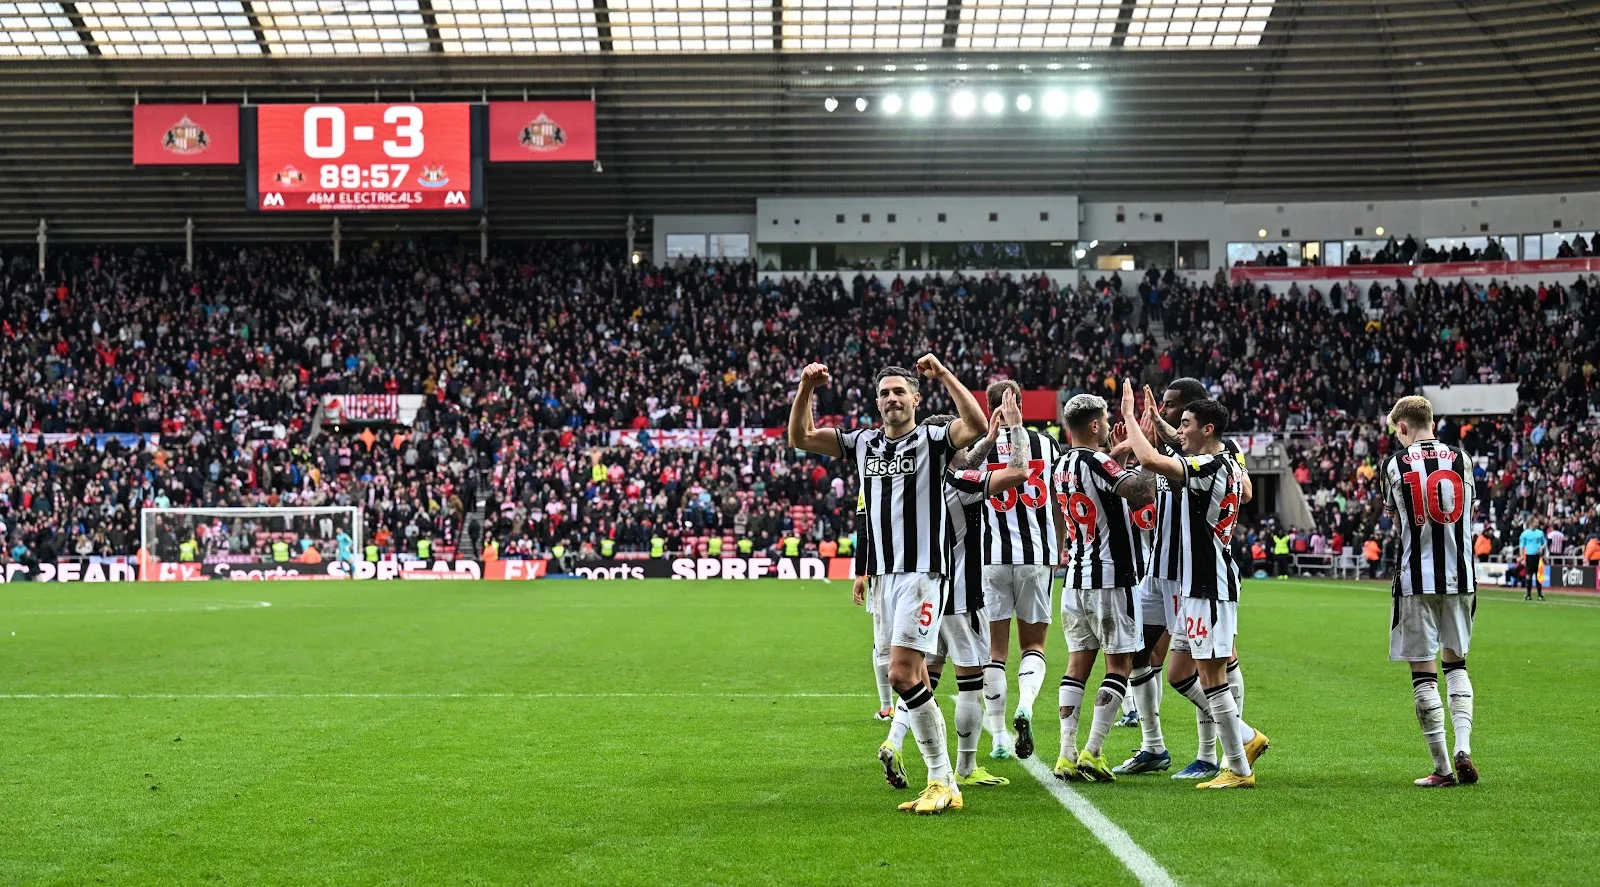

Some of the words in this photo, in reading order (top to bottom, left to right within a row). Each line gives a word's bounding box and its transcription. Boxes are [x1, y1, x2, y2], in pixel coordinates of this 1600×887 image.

[319, 163, 410, 189] 89:57
[339, 191, 423, 204] ELECTRICALS
[880, 455, 914, 475] sela
[1402, 450, 1458, 464] GORDON
[1403, 469, 1464, 526] 10
[919, 602, 933, 627] 5
[1186, 616, 1208, 640] 24
